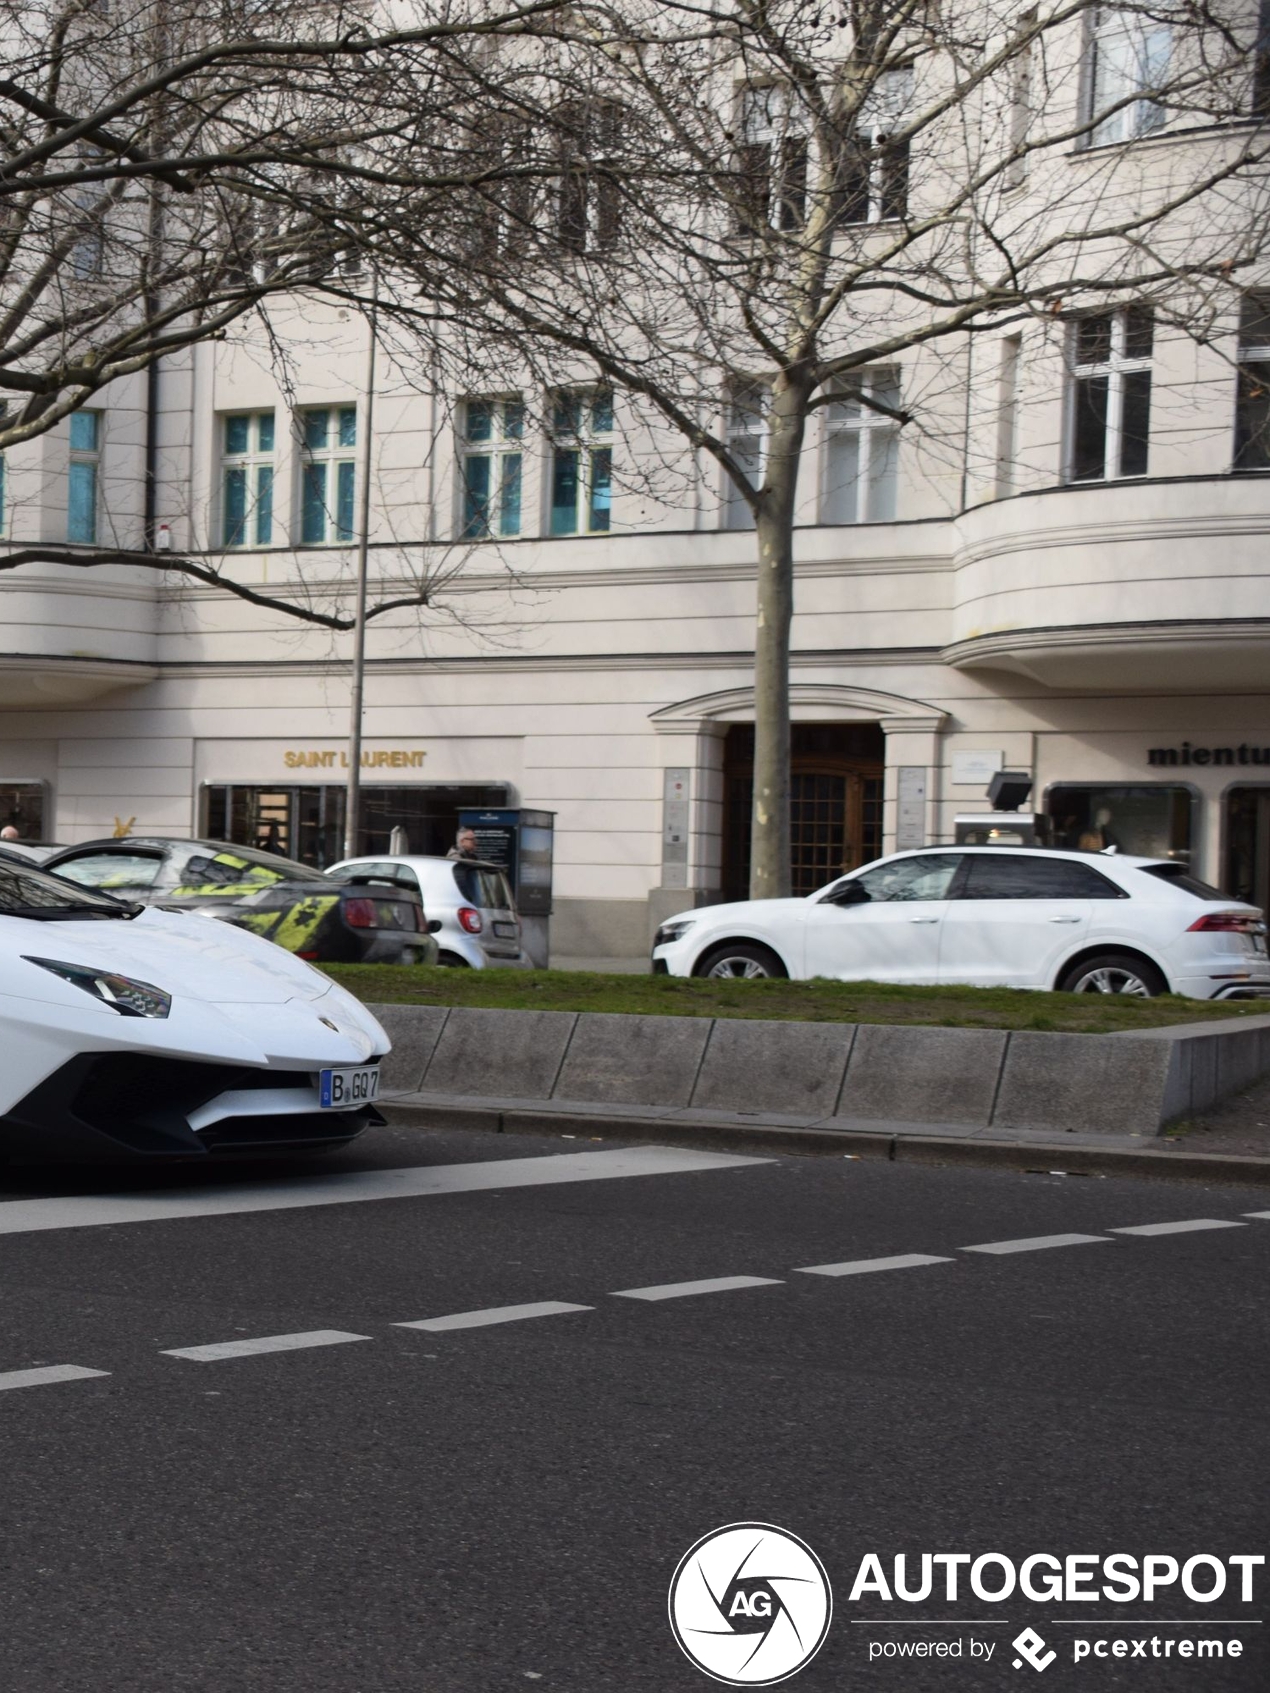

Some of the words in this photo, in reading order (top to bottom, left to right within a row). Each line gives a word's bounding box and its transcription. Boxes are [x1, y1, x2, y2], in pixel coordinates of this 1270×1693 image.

[284, 751, 336, 768] SAINT
[1147, 741, 1270, 766] mientu
[332, 1074, 343, 1102] B
[352, 1072, 368, 1099] GQ
